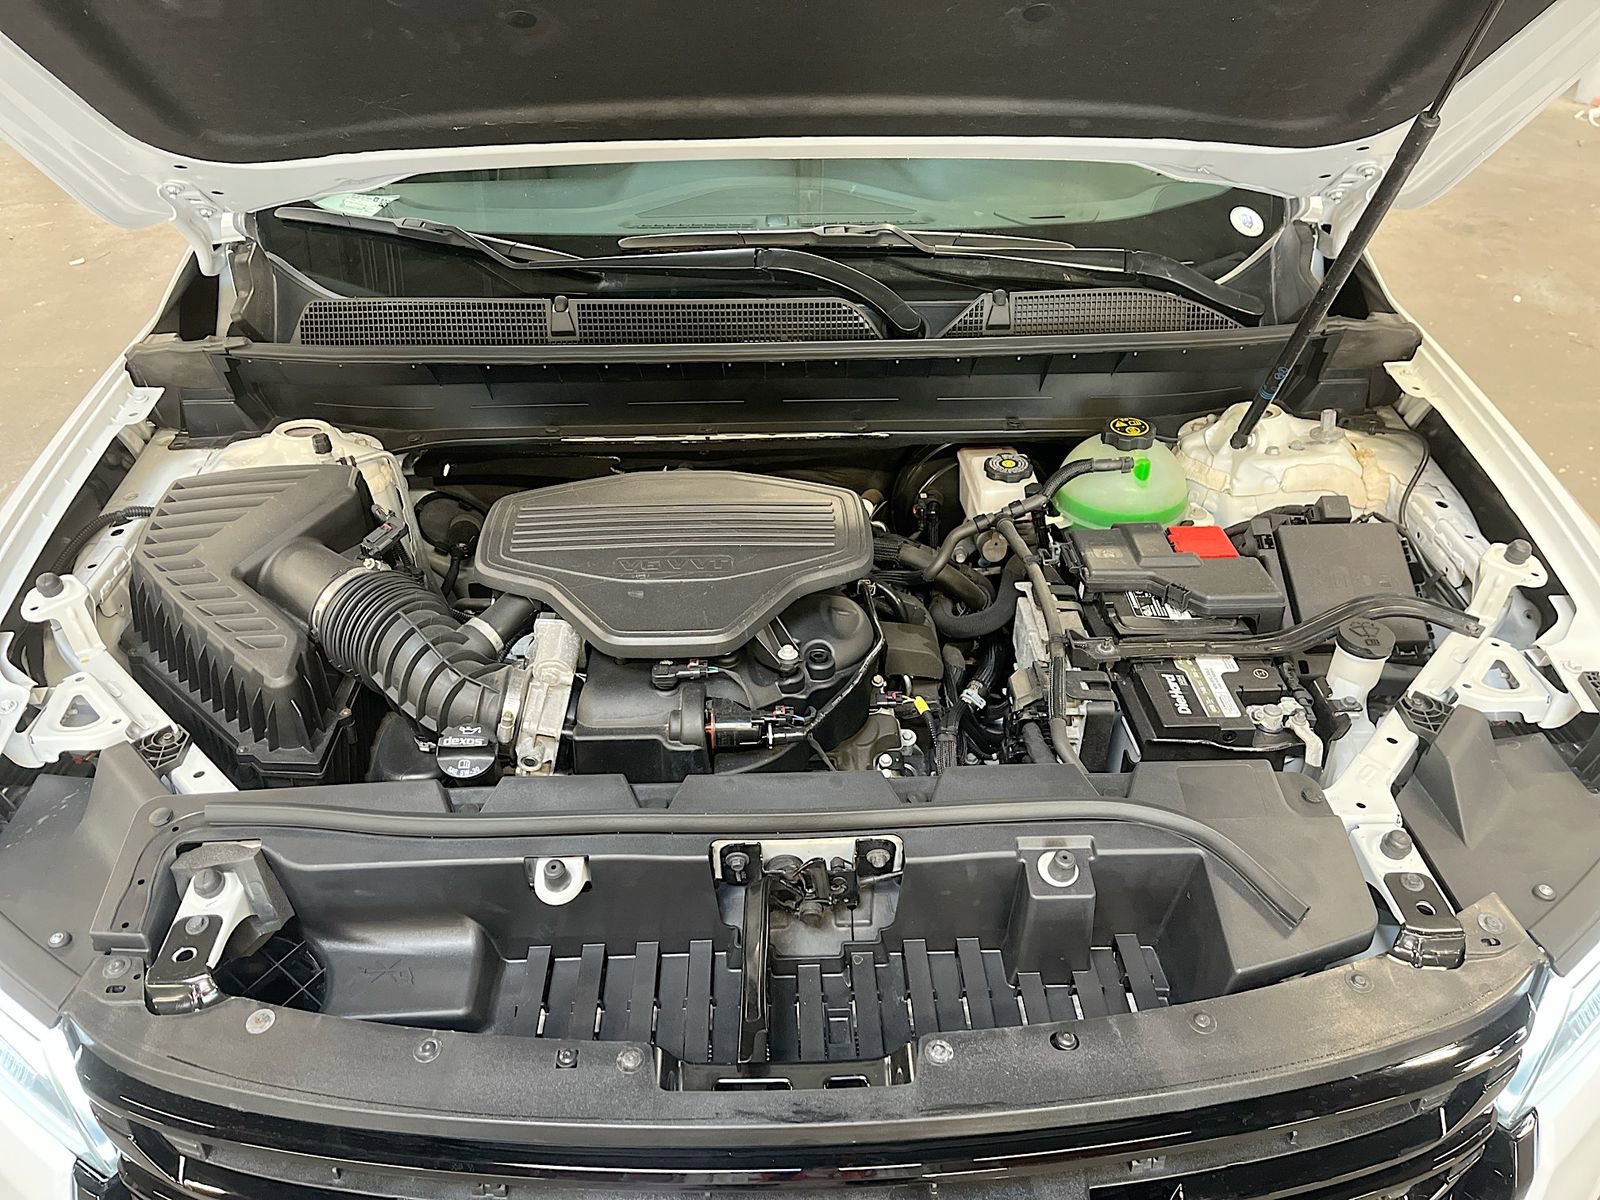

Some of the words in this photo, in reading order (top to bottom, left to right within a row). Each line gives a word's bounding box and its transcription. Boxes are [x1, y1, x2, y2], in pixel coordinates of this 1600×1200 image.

[666, 559, 729, 570] VVT
[1161, 673, 1193, 715] DieHard
[443, 736, 485, 746] dexos
